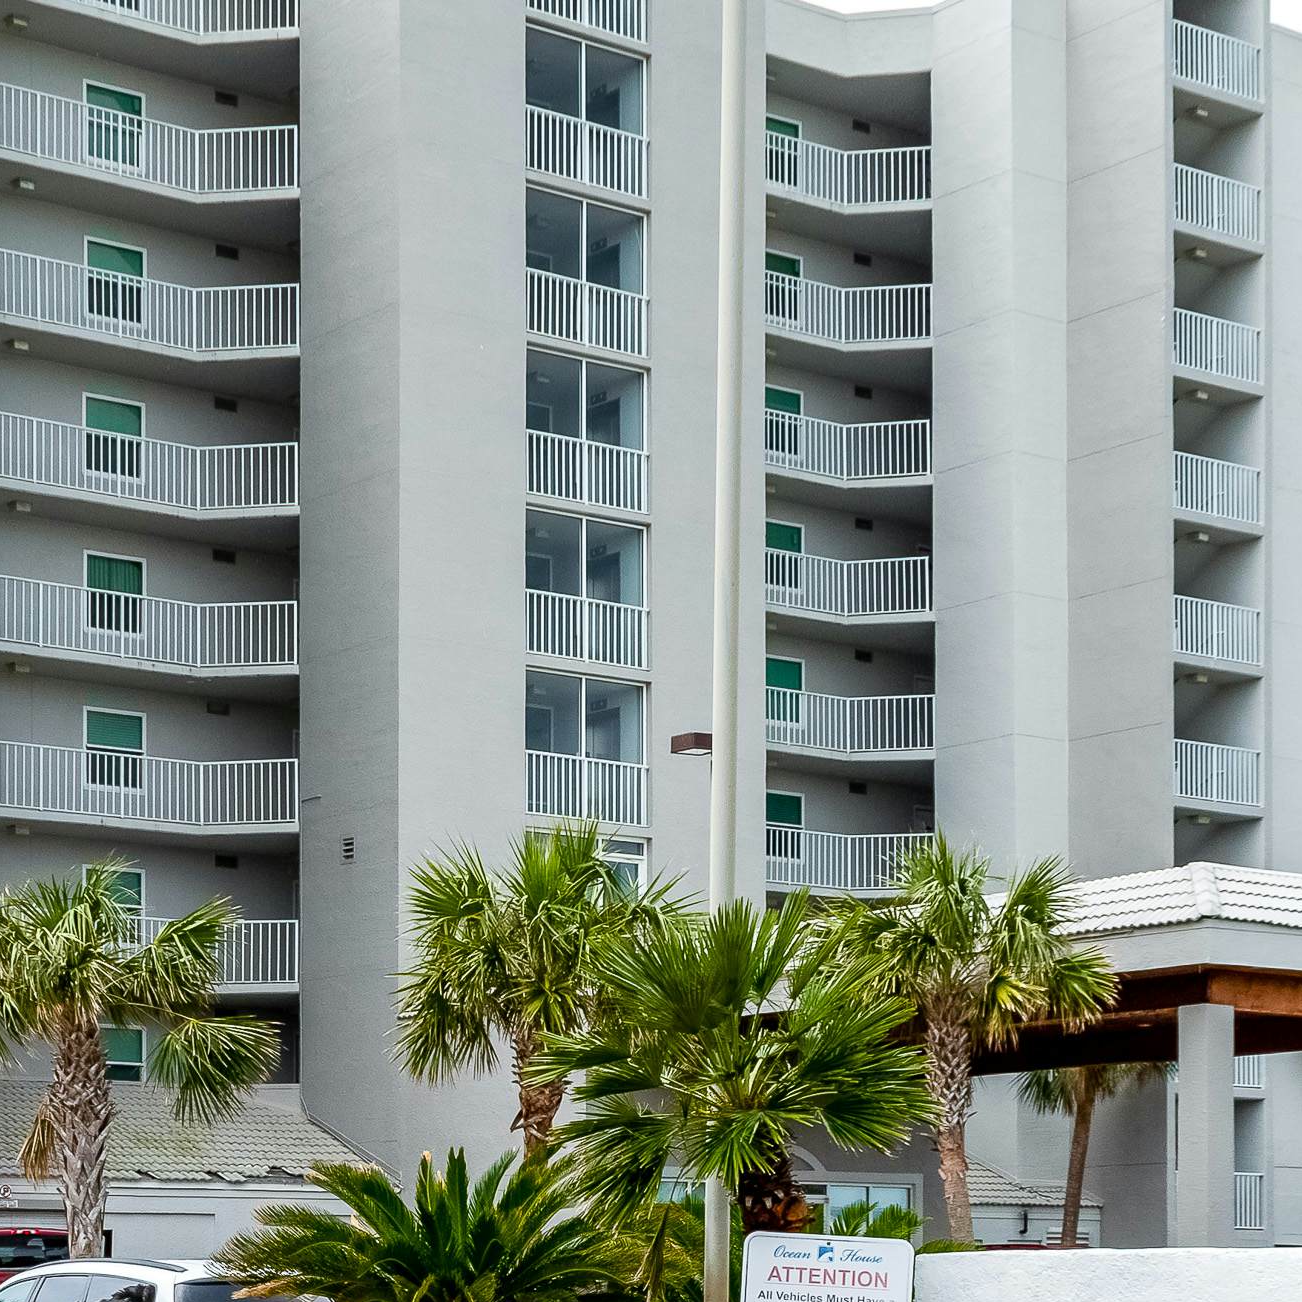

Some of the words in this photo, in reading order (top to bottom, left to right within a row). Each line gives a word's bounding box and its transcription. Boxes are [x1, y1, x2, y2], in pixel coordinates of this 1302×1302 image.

[773, 1244, 811, 1260] Ocean
[839, 1249, 882, 1264] House
[767, 1265, 888, 1288] ATTENTION
[757, 1290, 773, 1300] All
[776, 1291, 822, 1302] Vehicles
